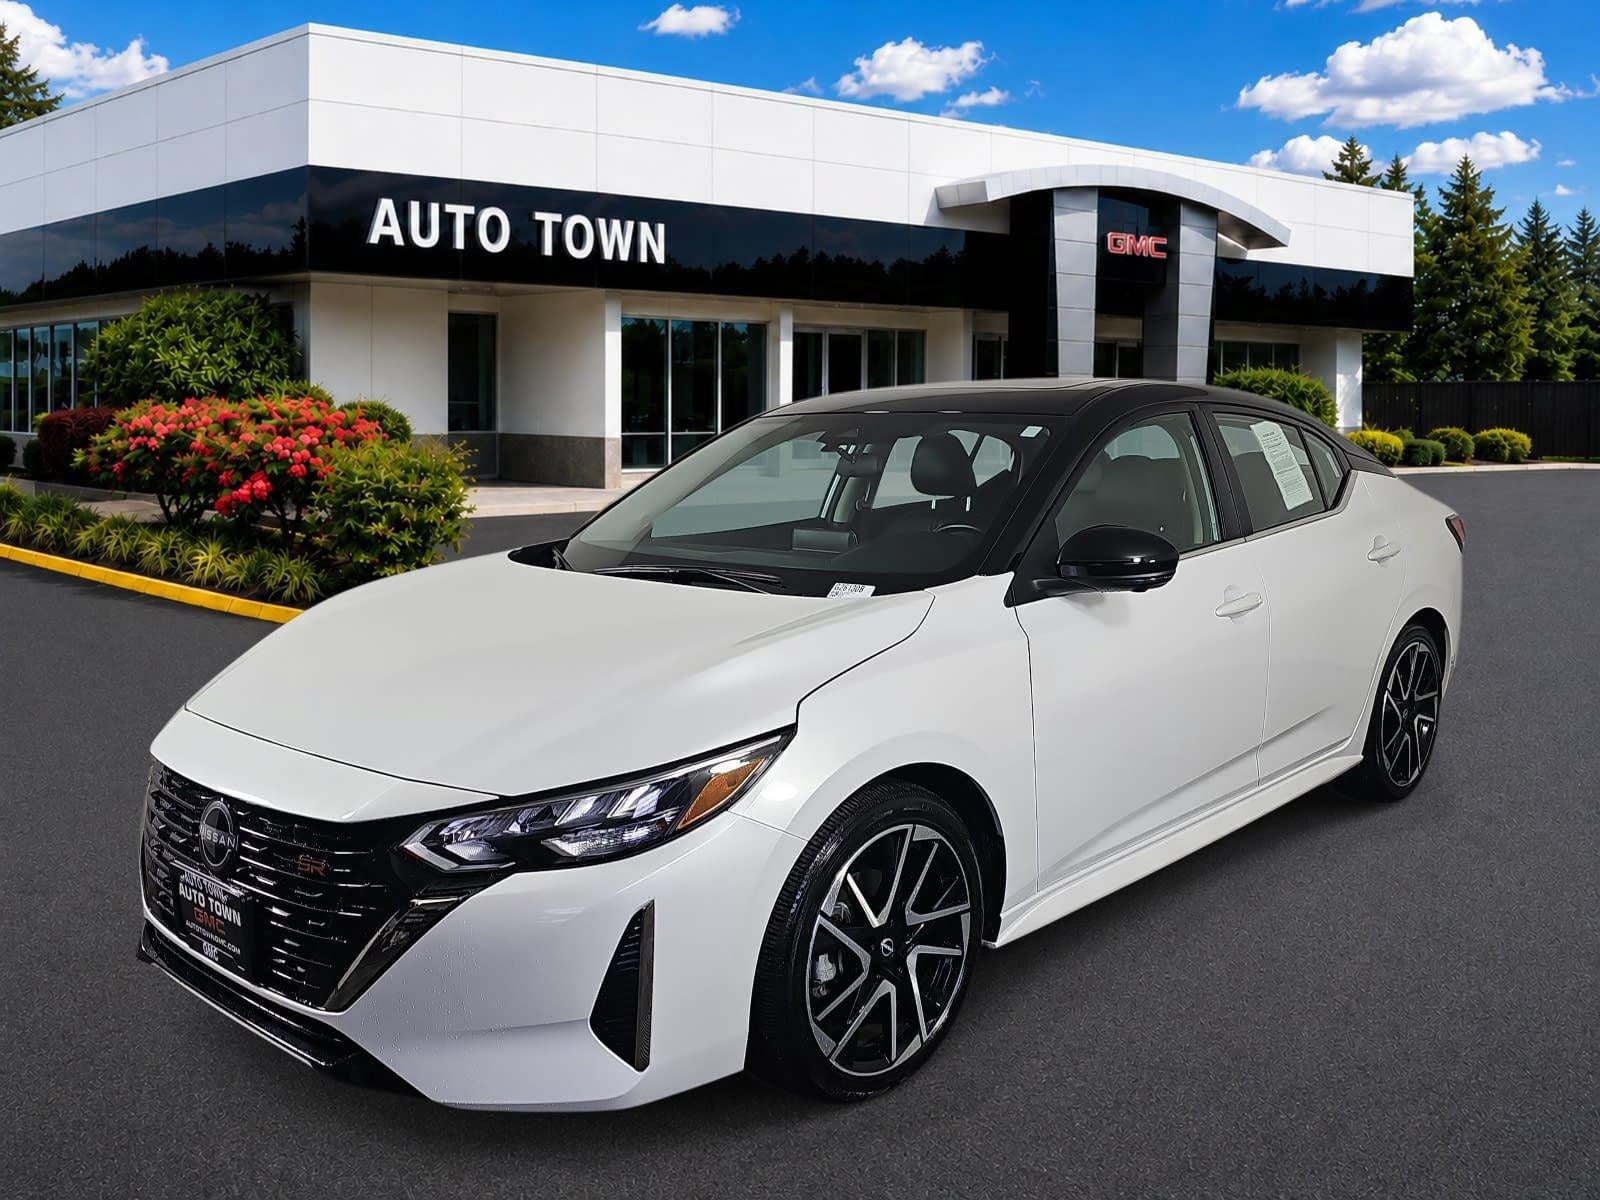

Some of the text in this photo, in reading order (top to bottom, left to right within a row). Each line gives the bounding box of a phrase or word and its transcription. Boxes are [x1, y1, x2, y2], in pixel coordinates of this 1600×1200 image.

[367, 198, 666, 264] AUTO TOWN
[1107, 232, 1167, 259] GMC
[200, 825, 236, 849] NISSAN
[294, 855, 326, 876] SR
[179, 882, 242, 927] AUTO TOWN
[194, 907, 226, 935] GMC
